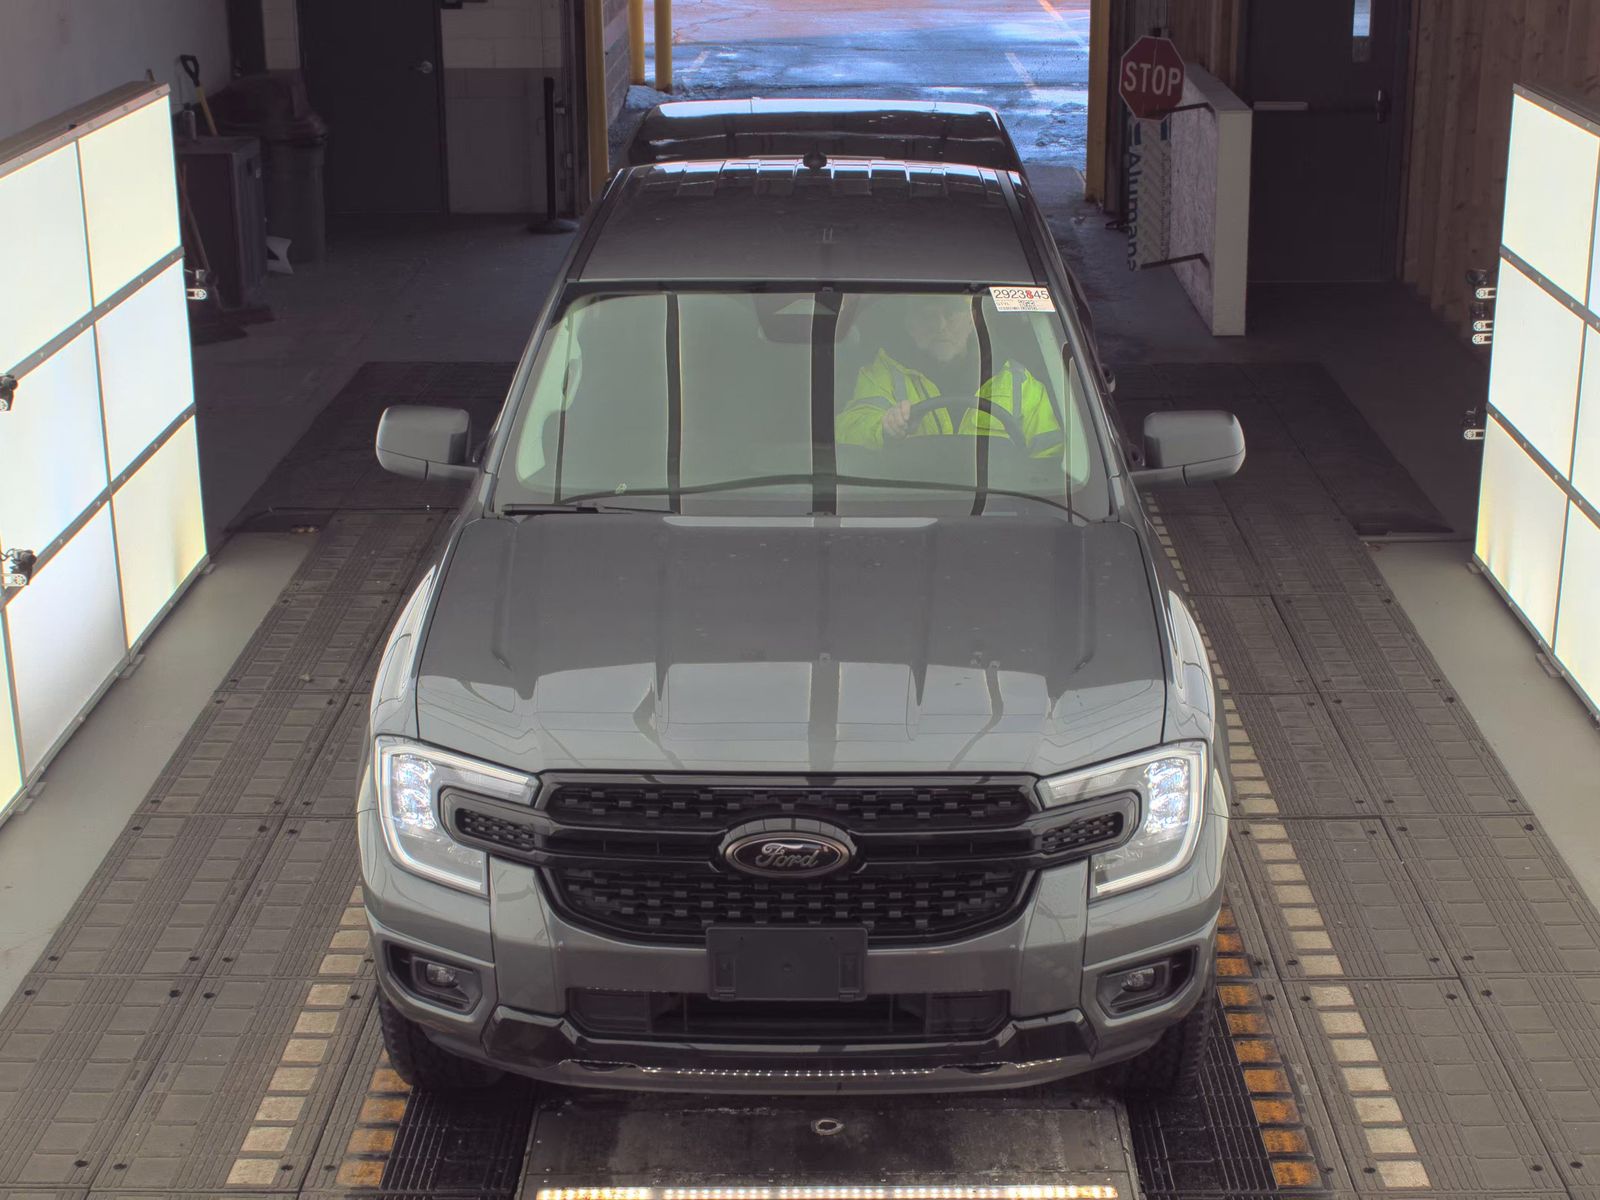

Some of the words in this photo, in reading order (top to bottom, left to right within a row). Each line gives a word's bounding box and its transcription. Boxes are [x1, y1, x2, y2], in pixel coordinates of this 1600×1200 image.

[1123, 61, 1181, 97] STOP
[993, 289, 1050, 300] 2923845
[755, 843, 821, 868] Ford
